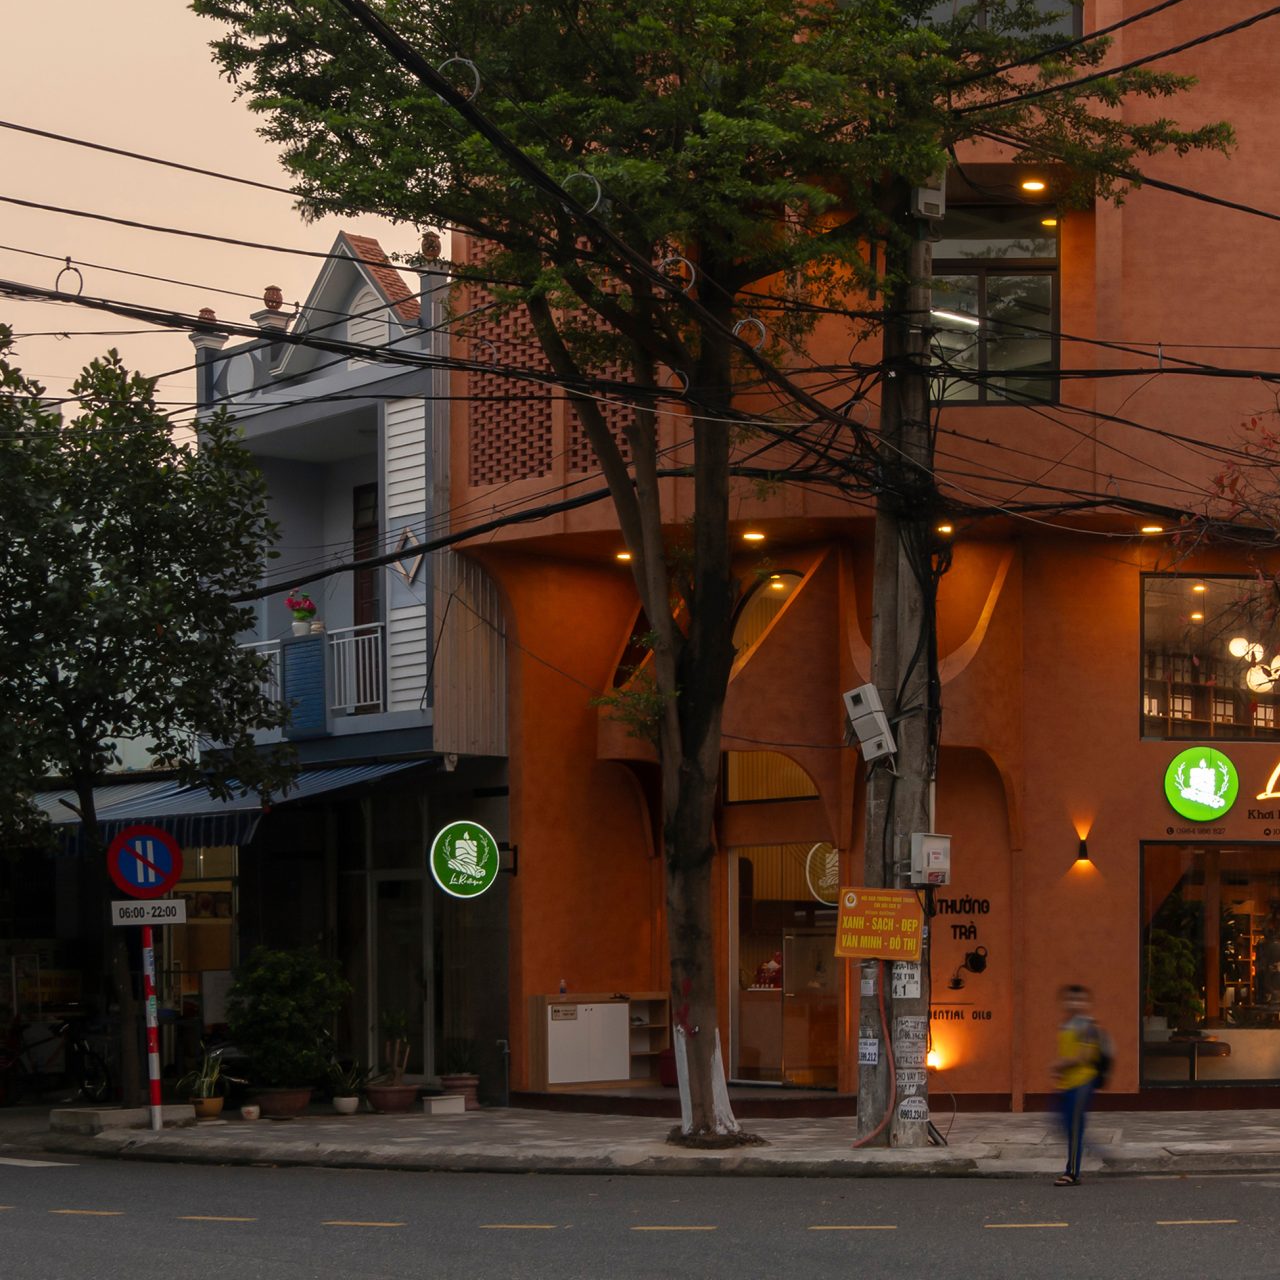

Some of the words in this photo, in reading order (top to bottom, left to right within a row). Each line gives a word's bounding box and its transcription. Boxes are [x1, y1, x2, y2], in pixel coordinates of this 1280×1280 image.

[119, 907, 145, 918] 06:00
[151, 906, 177, 917] 22:00
[842, 916, 864, 929] XANH
[872, 917, 894, 933] SẠCH
[951, 921, 977, 940] TRÀ
[842, 932, 858, 947] VĂN
[860, 935, 882, 949] MINH
[903, 938, 916, 954] THỊ
[972, 1010, 992, 1020] OILS
